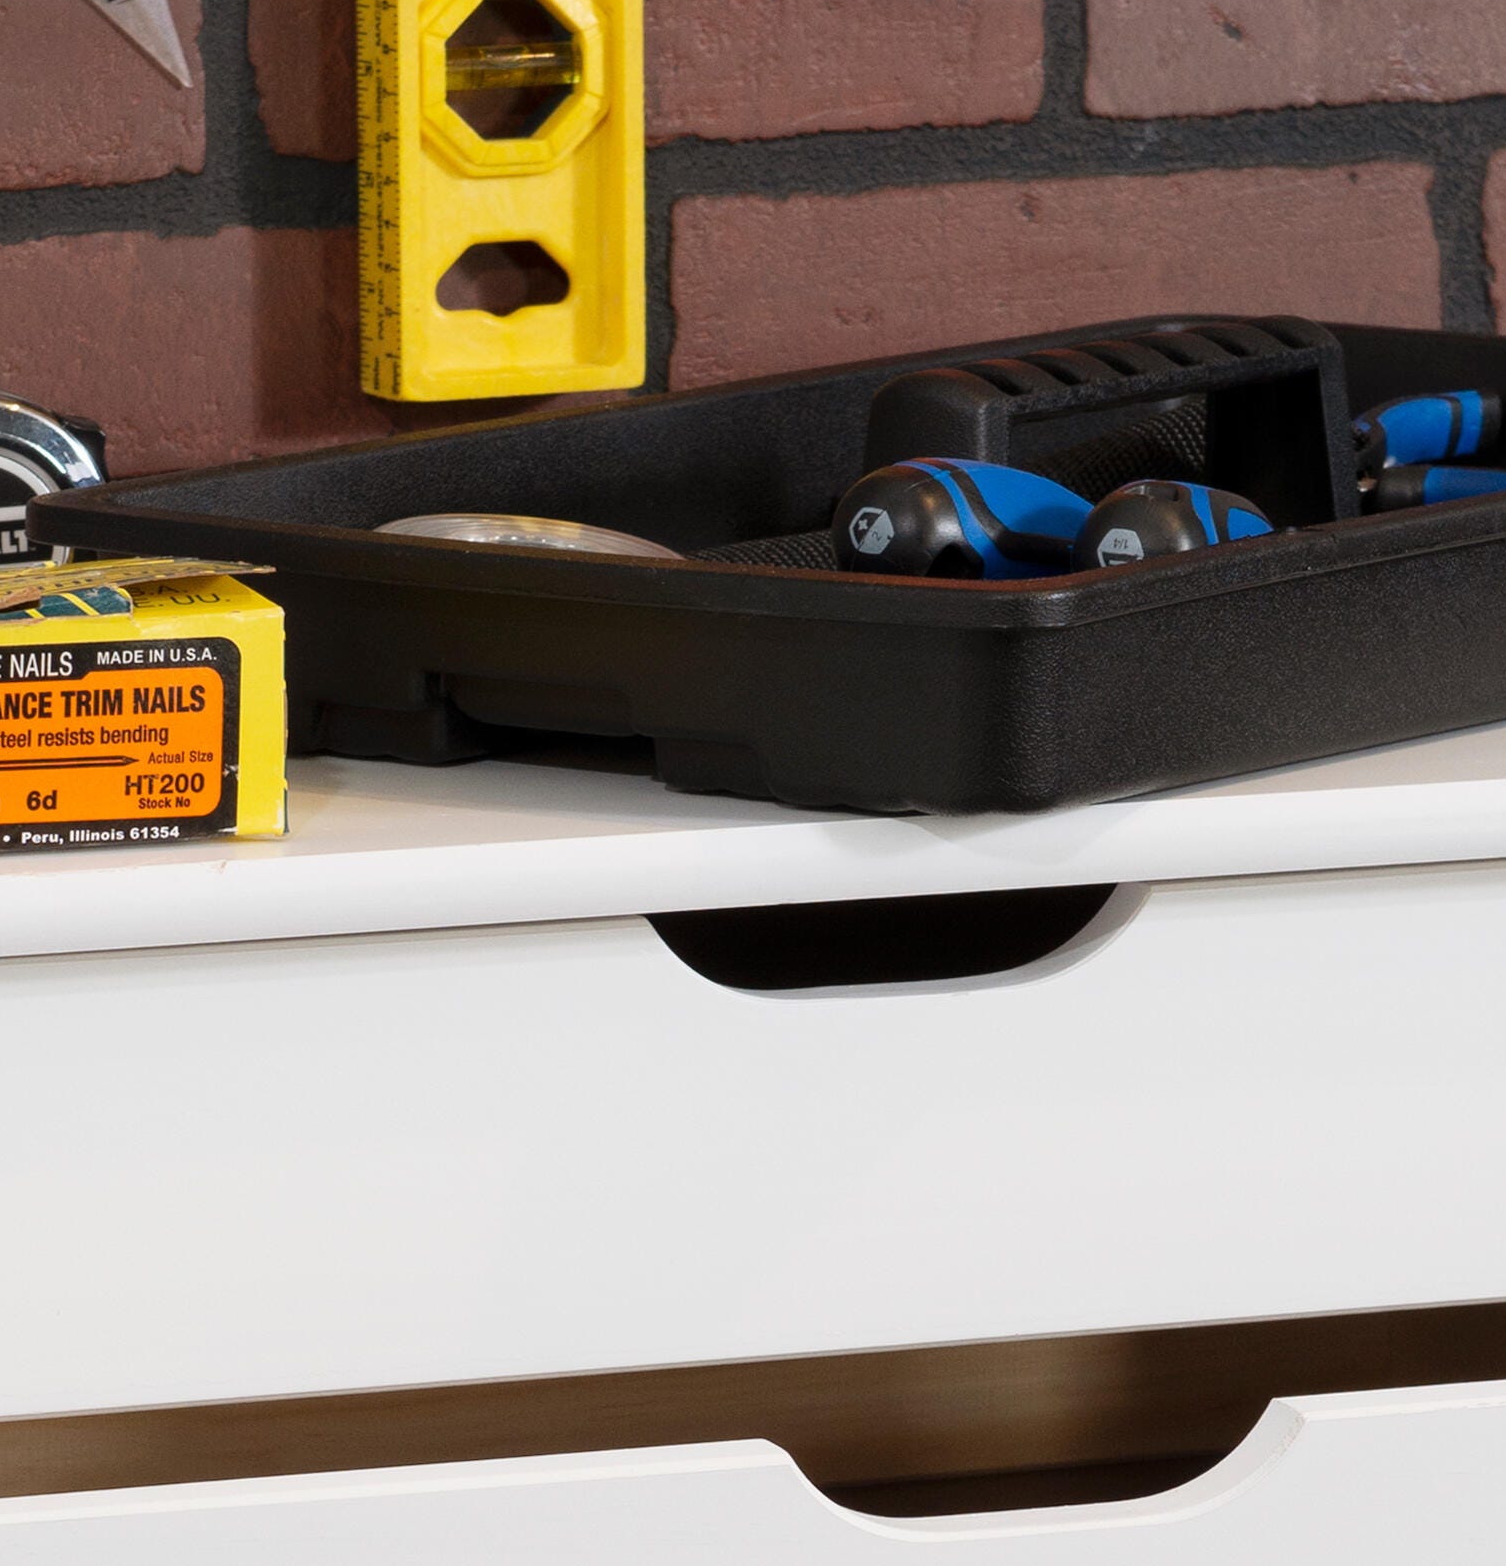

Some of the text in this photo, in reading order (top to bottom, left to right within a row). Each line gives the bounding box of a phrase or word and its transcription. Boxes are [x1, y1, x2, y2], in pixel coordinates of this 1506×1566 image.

[10, 652, 73, 678] NAILS
[97, 648, 217, 665] MADE IN U.S.A.
[61, 688, 123, 717] TRIM
[133, 685, 205, 714] NAILS
[37, 727, 94, 747] resists
[100, 725, 169, 745] bending
[148, 751, 184, 764] Actual
[125, 773, 205, 796] HT200
[27, 790, 57, 810] 6d
[138, 797, 191, 809] Stock No
[21, 826, 180, 845] Peru, Illinois 61354
